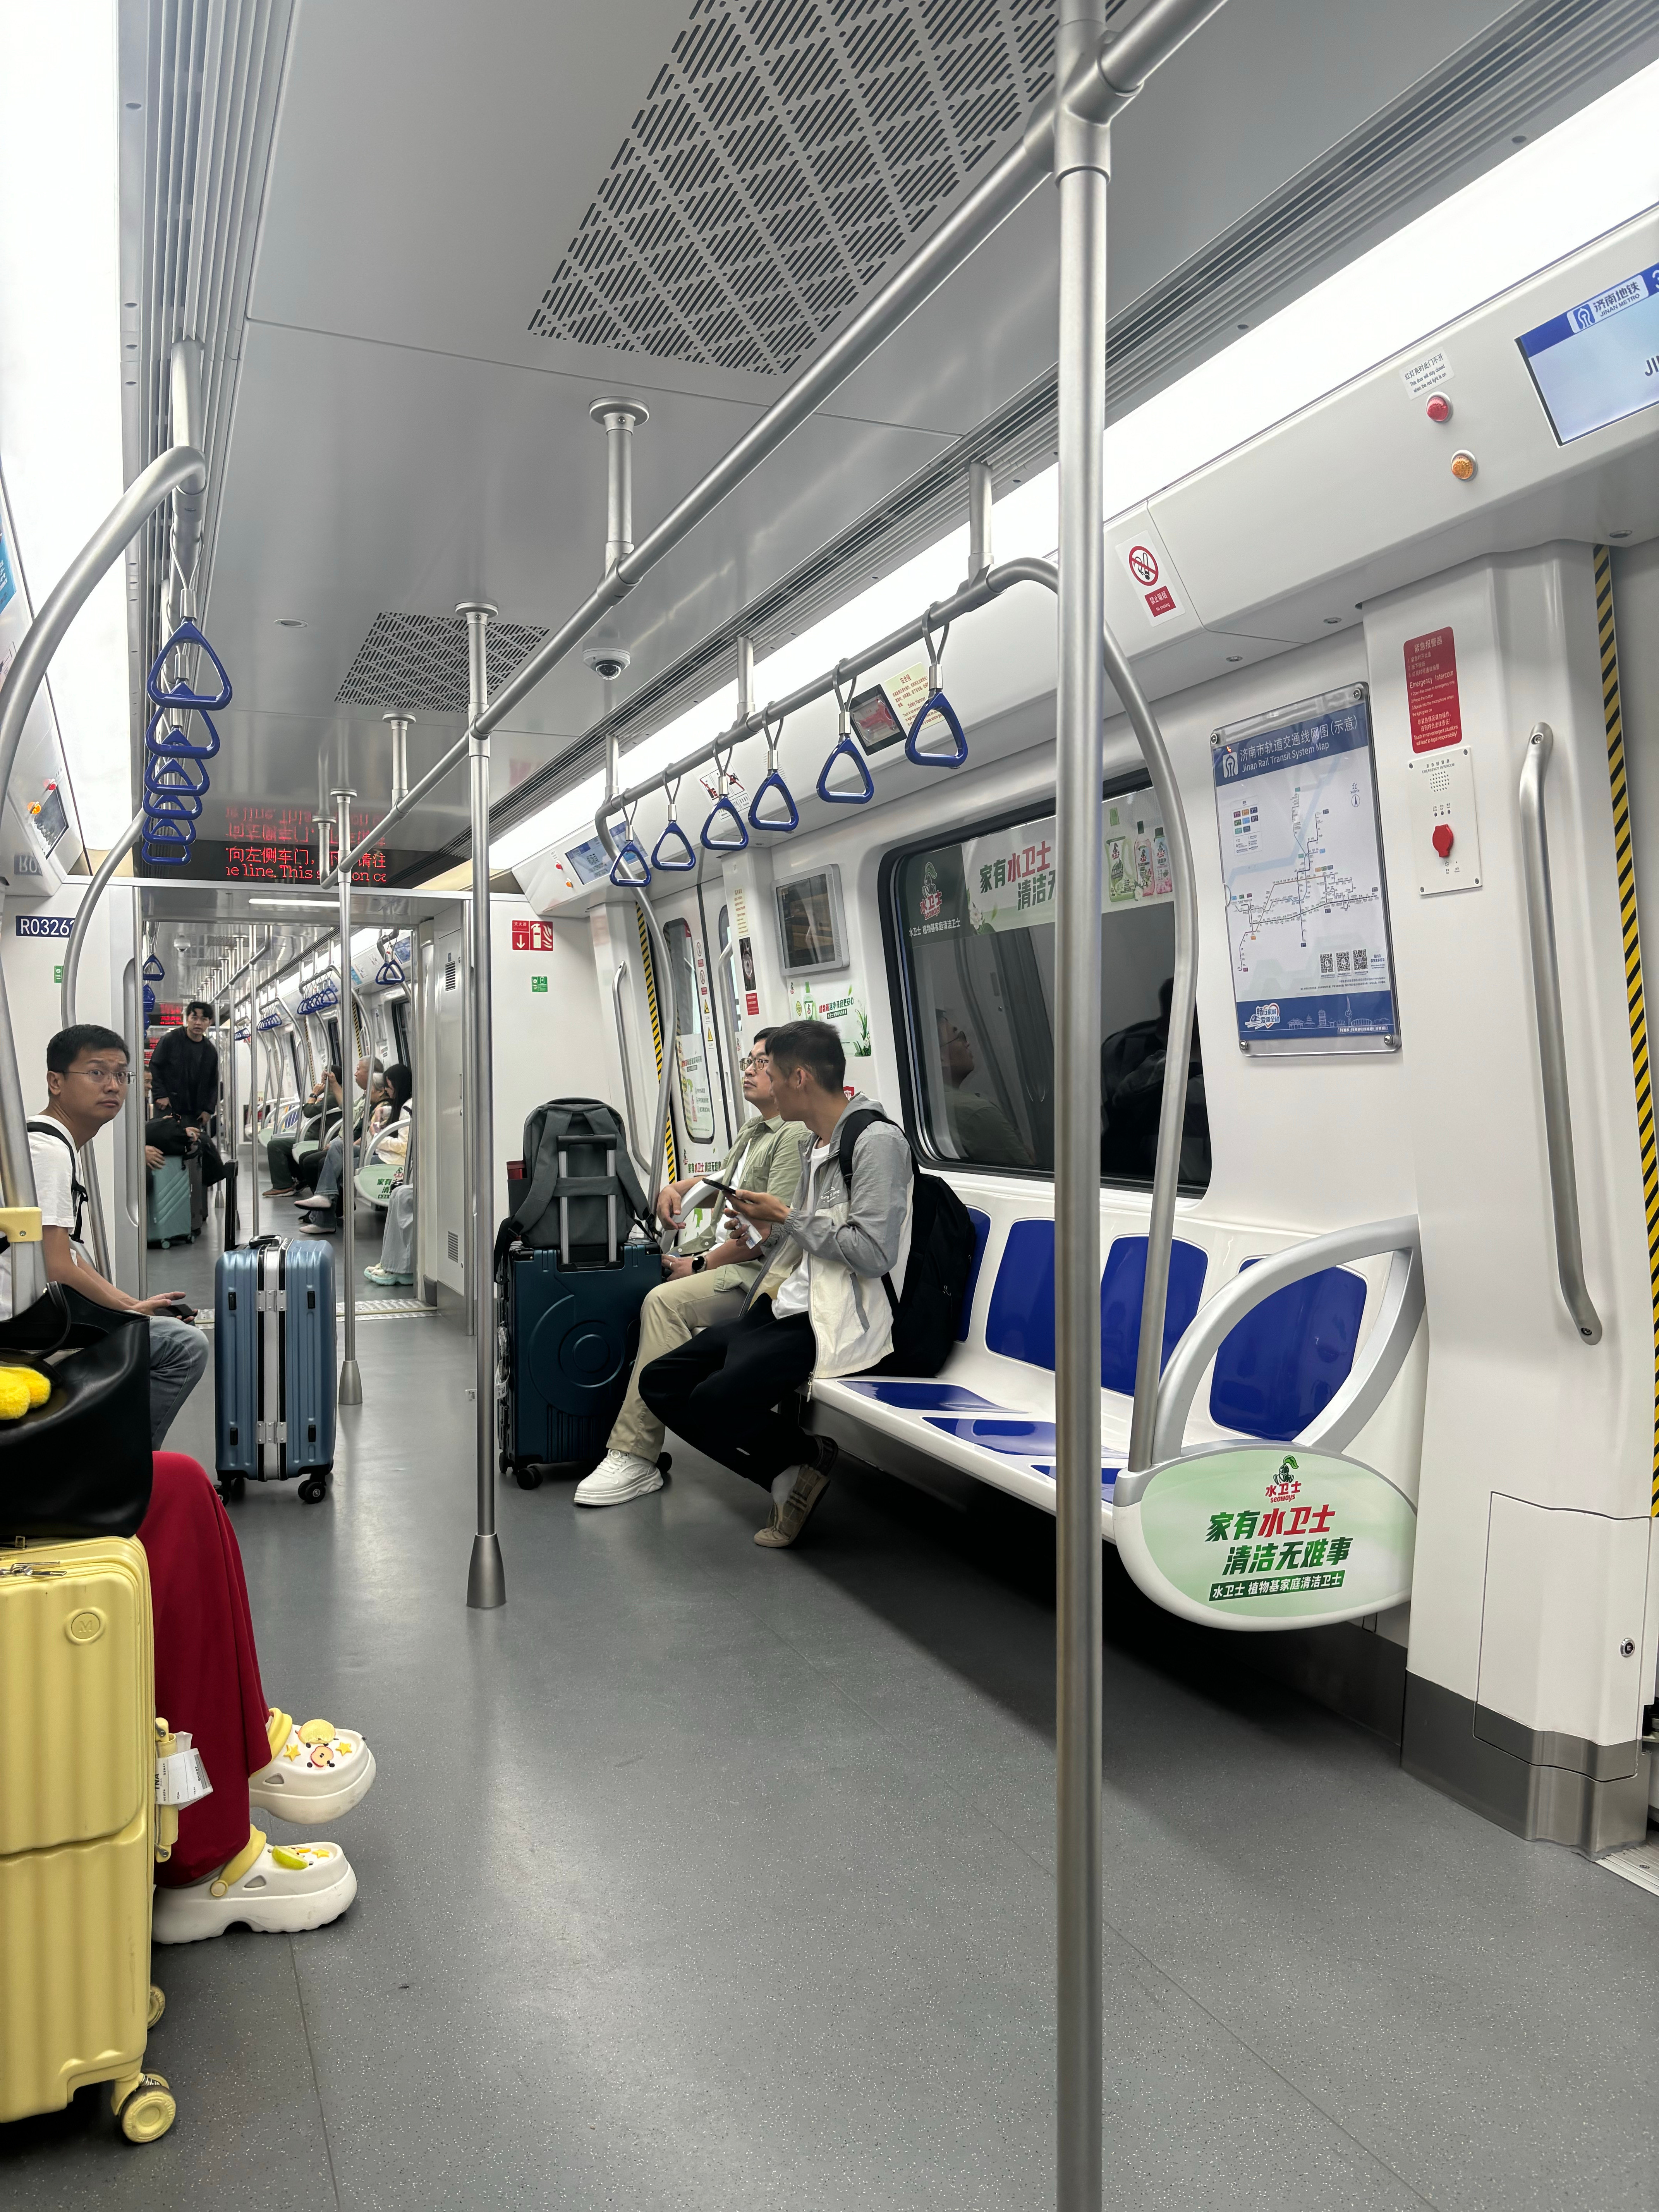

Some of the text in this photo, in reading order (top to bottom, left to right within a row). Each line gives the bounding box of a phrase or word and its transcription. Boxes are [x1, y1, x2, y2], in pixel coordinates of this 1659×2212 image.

[1593, 282, 1640, 313] 济南地铁
[1600, 293, 1640, 317] JINAN METRO
[1404, 353, 1443, 380] 红灯亮时此门不开
[1644, 355, 1659, 376] JI
[1149, 591, 1168, 605] 禁止吸烟
[1410, 671, 1453, 689] Emergency Intercom
[1242, 742, 1329, 773] Jinan Rail Transit System Map
[279, 865, 313, 879] This
[980, 840, 1051, 893] 家有水卫士
[920, 890, 942, 914] 水卫士
[909, 926, 921, 937] 水卫士
[1265, 1480, 1302, 1497] 水卫士
[1270, 1494, 1296, 1503] seaways
[1204, 1504, 1336, 1542] 家有水卫士
[1222, 1537, 1353, 1576] 清洁无难事
[1212, 1573, 1342, 1599] 水卫士 植物基家庭清洁卫士
